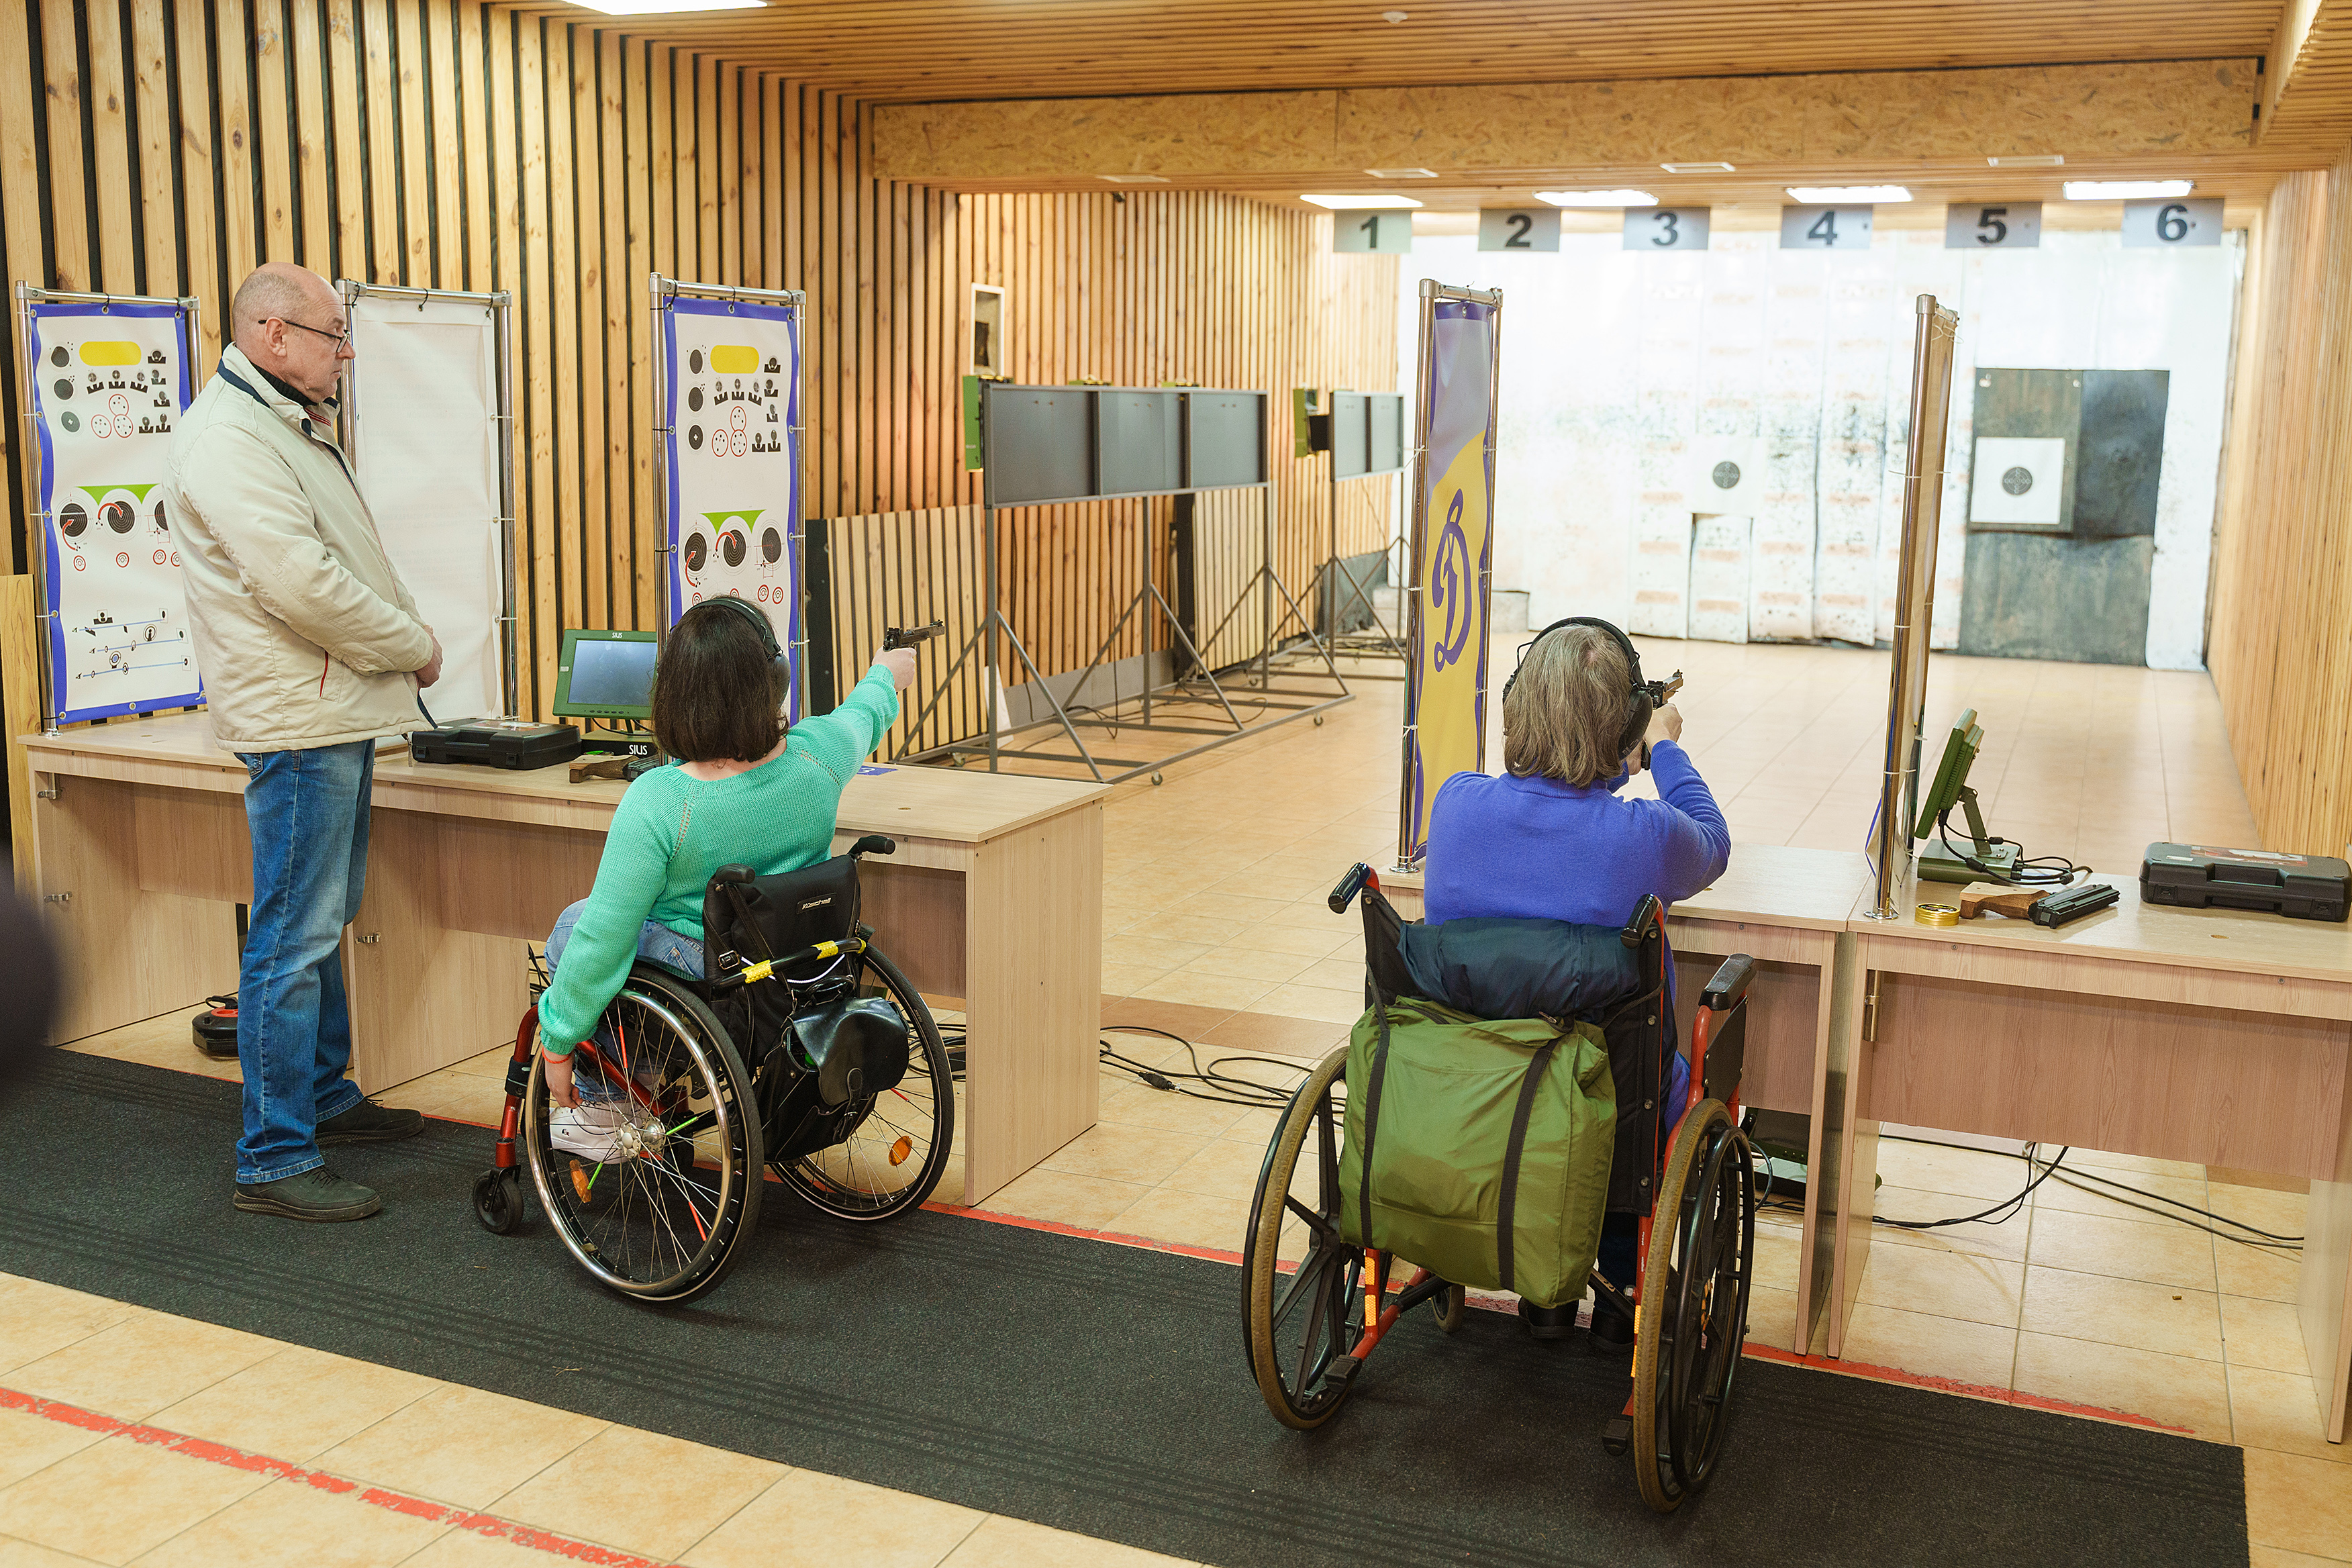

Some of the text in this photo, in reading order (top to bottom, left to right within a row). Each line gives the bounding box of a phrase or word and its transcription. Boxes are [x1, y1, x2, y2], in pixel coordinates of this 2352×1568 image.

[1360, 215, 1379, 248] 1
[1504, 213, 1532, 248] 2
[1652, 211, 1679, 246] 3
[1808, 210, 1838, 245] 4
[1976, 207, 2008, 244] 5
[2156, 203, 2188, 241] 6
[628, 744, 648, 755] SIUS
